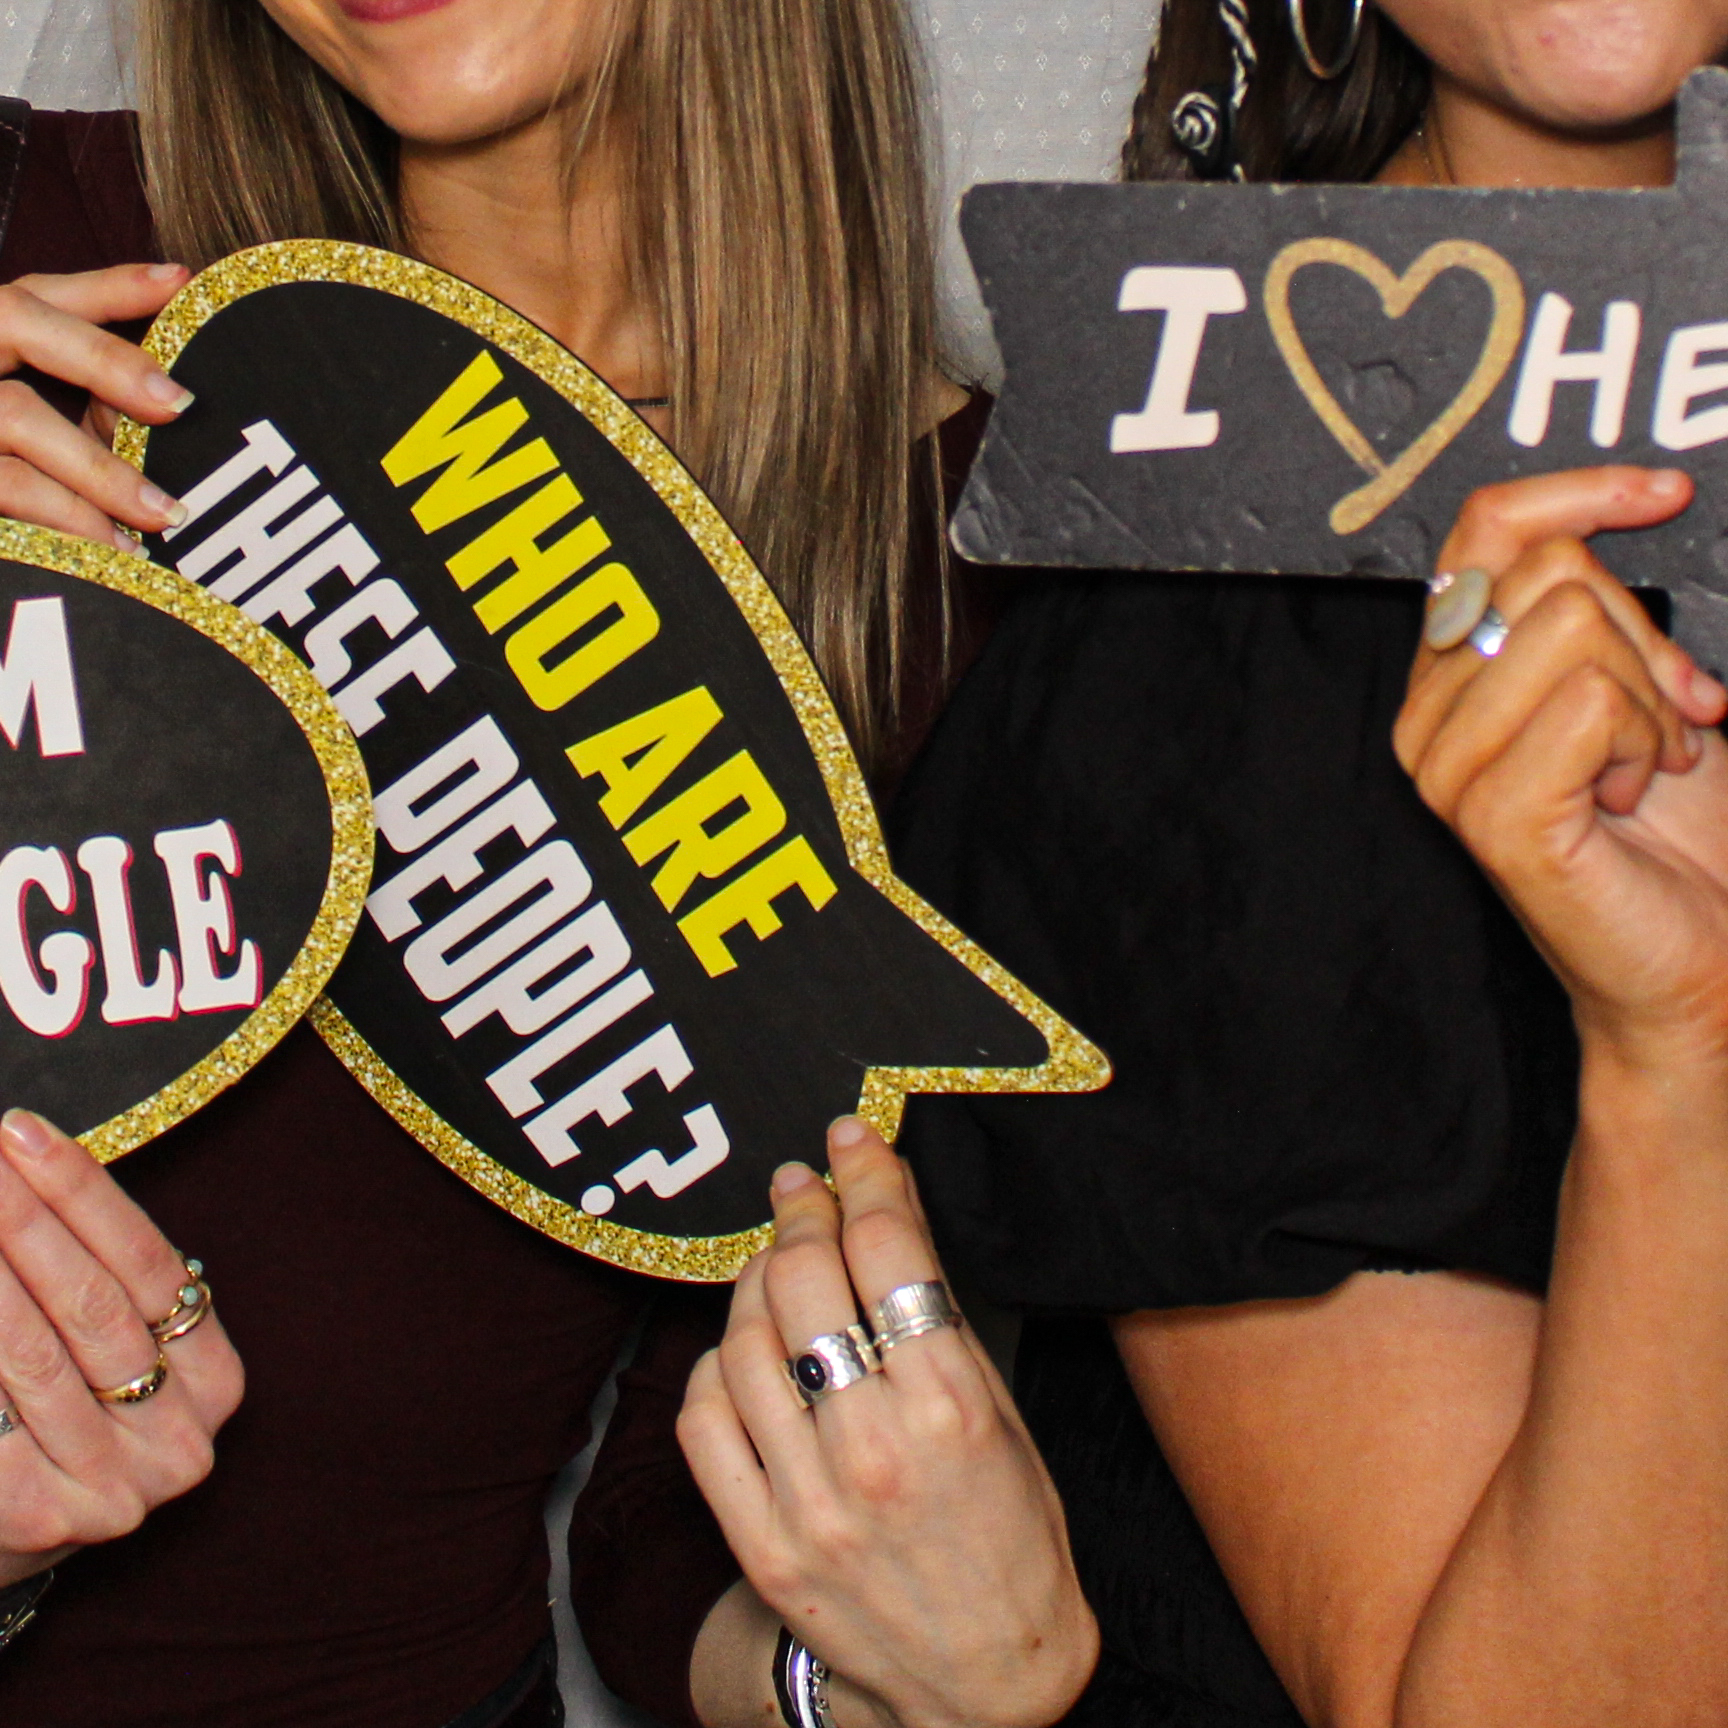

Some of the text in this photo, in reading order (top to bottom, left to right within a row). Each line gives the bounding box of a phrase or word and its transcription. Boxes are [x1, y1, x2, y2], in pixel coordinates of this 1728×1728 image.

[380, 348, 838, 979] WHO ARE
[1108, 264, 1248, 454] I
[161, 418, 730, 1216] THESE PEOPLE?
